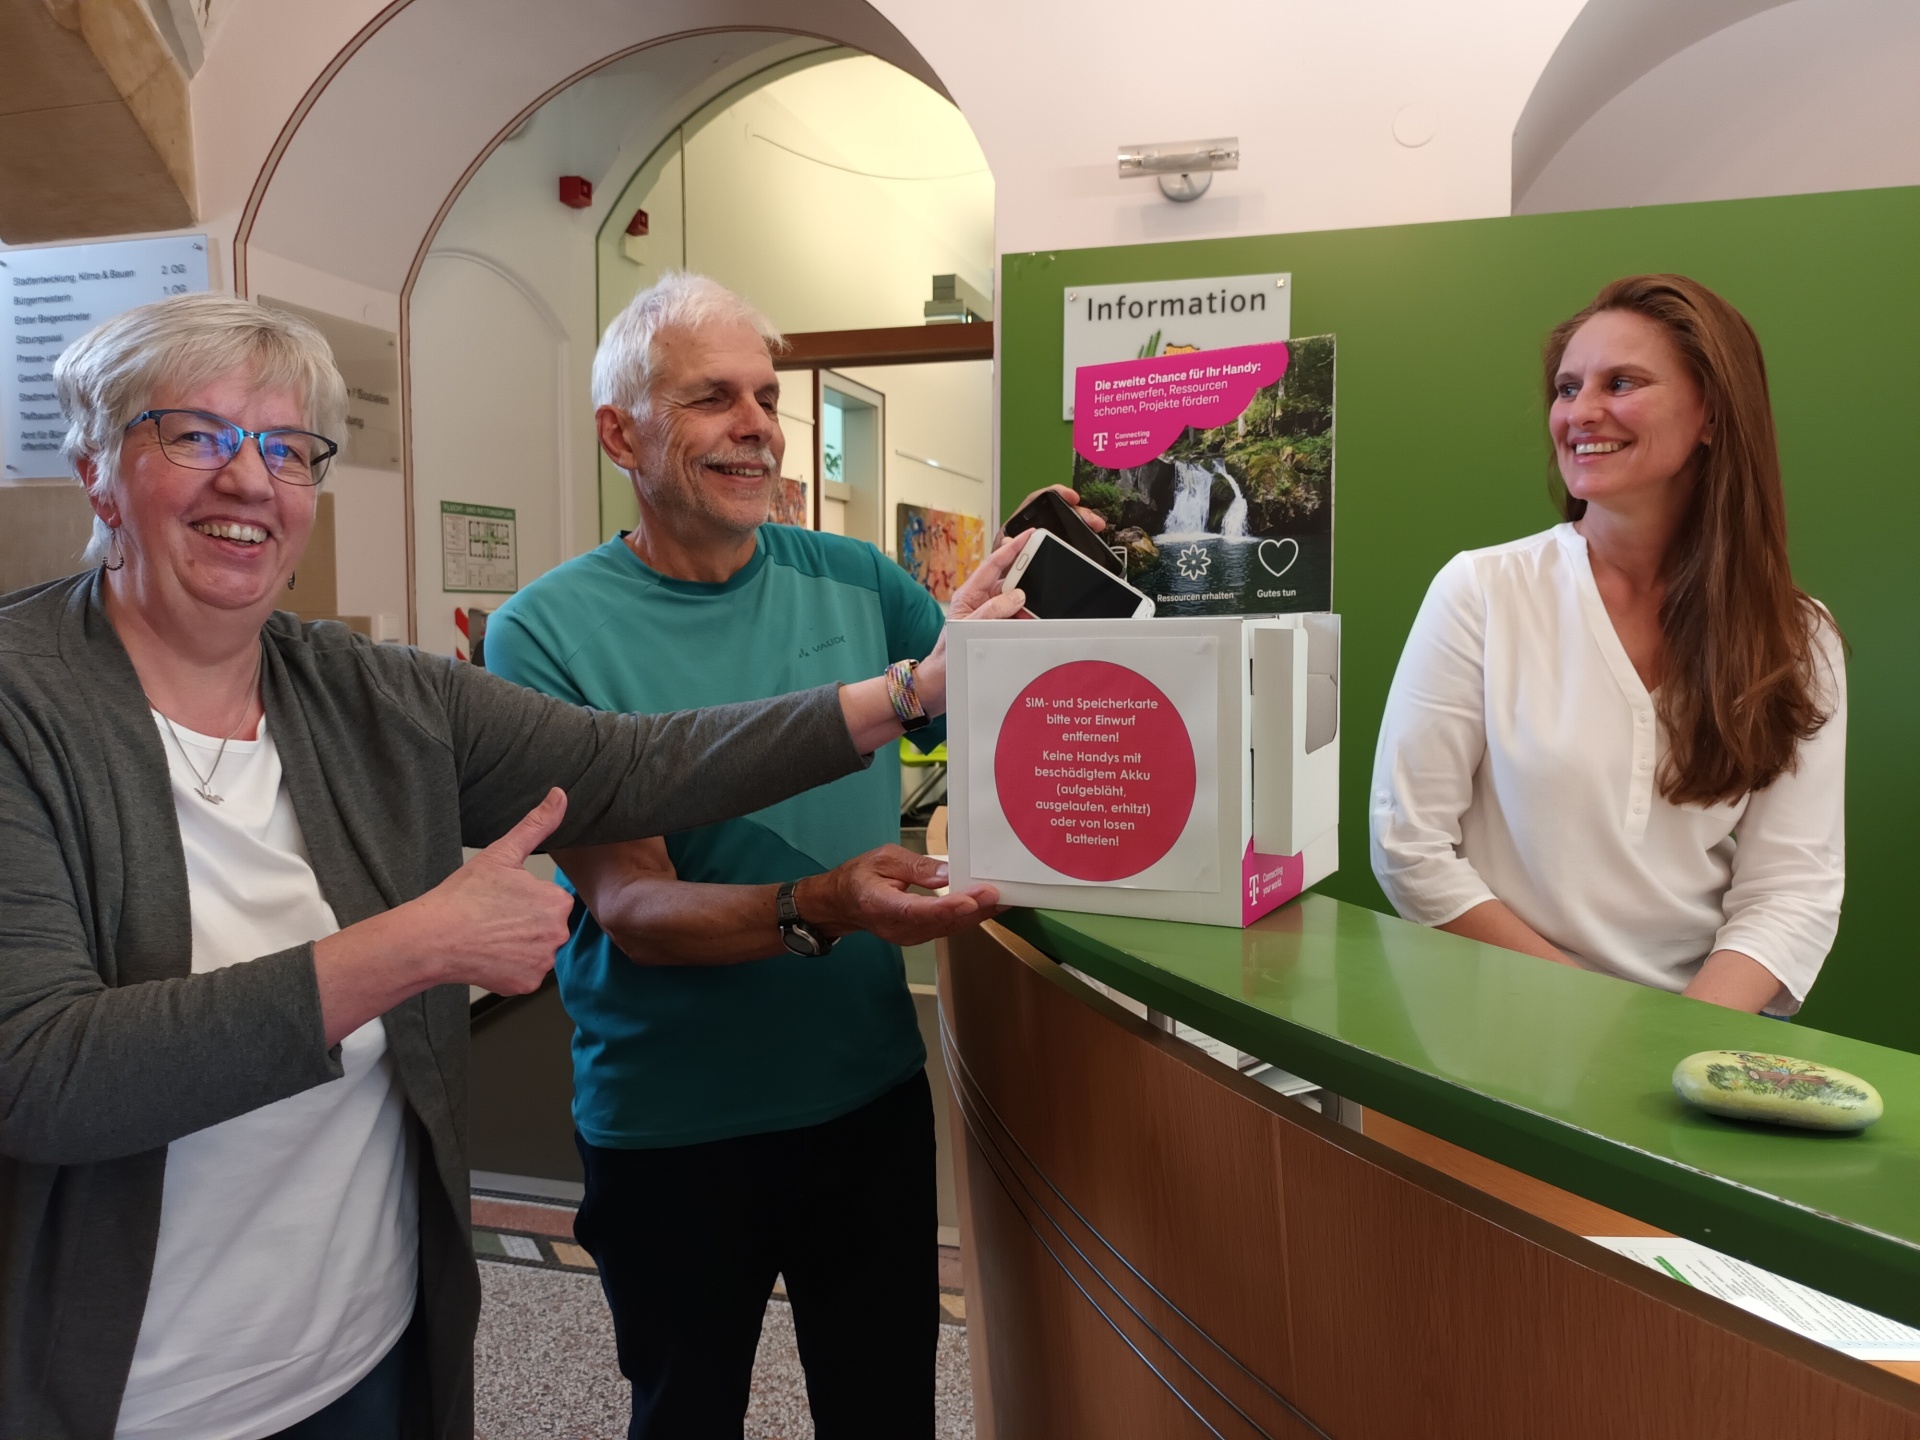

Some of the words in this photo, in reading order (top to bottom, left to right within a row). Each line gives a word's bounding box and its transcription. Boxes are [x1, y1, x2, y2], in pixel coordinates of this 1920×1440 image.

[102, 270, 109, 279] &
[110, 269, 135, 278] Bauen
[1087, 289, 1266, 322] Information
[1094, 380, 1111, 391] Die
[1113, 376, 1146, 389] zweite
[1148, 371, 1187, 385] Chance
[1189, 368, 1205, 380] für
[1206, 366, 1221, 378] Ihr
[1222, 362, 1261, 376] Handy:
[1094, 393, 1115, 404] Hier
[1116, 386, 1167, 401] einwerfen,
[1169, 379, 1228, 395] Ressourcen
[1094, 404, 1137, 417] schonen,
[1139, 398, 1179, 412] Projekte
[1182, 394, 1219, 407] fördern
[1115, 430, 1150, 440] Connecting
[1115, 440, 1128, 448] your
[1130, 438, 1148, 446] world.
[1157, 593, 1200, 602] Ressourcen
[1201, 591, 1234, 601] erhalten
[1256, 589, 1281, 598] Gutes
[1282, 589, 1296, 597] tun
[1025, 697, 1049, 708] SIM-
[1052, 697, 1074, 709] und
[1076, 698, 1158, 711] Speicherkarte
[1046, 714, 1071, 725] bitte
[1074, 716, 1092, 725] vor
[1095, 714, 1136, 726] Einwurf
[1062, 731, 1119, 743] entfernen!
[1042, 750, 1073, 762] Keine
[1076, 751, 1119, 765] Handys
[1122, 752, 1141, 764] mit
[1034, 766, 1116, 781] beschädigtem
[1120, 769, 1150, 781] Akku
[1056, 783, 1127, 798] (aufgebläht,
[1035, 800, 1108, 814] ausgelaufen,
[1111, 803, 1151, 817] erhitzt)
[1050, 817, 1076, 828] oder
[1079, 818, 1100, 829] von
[1103, 819, 1135, 831] losen
[1065, 833, 1119, 846] Batterien!
